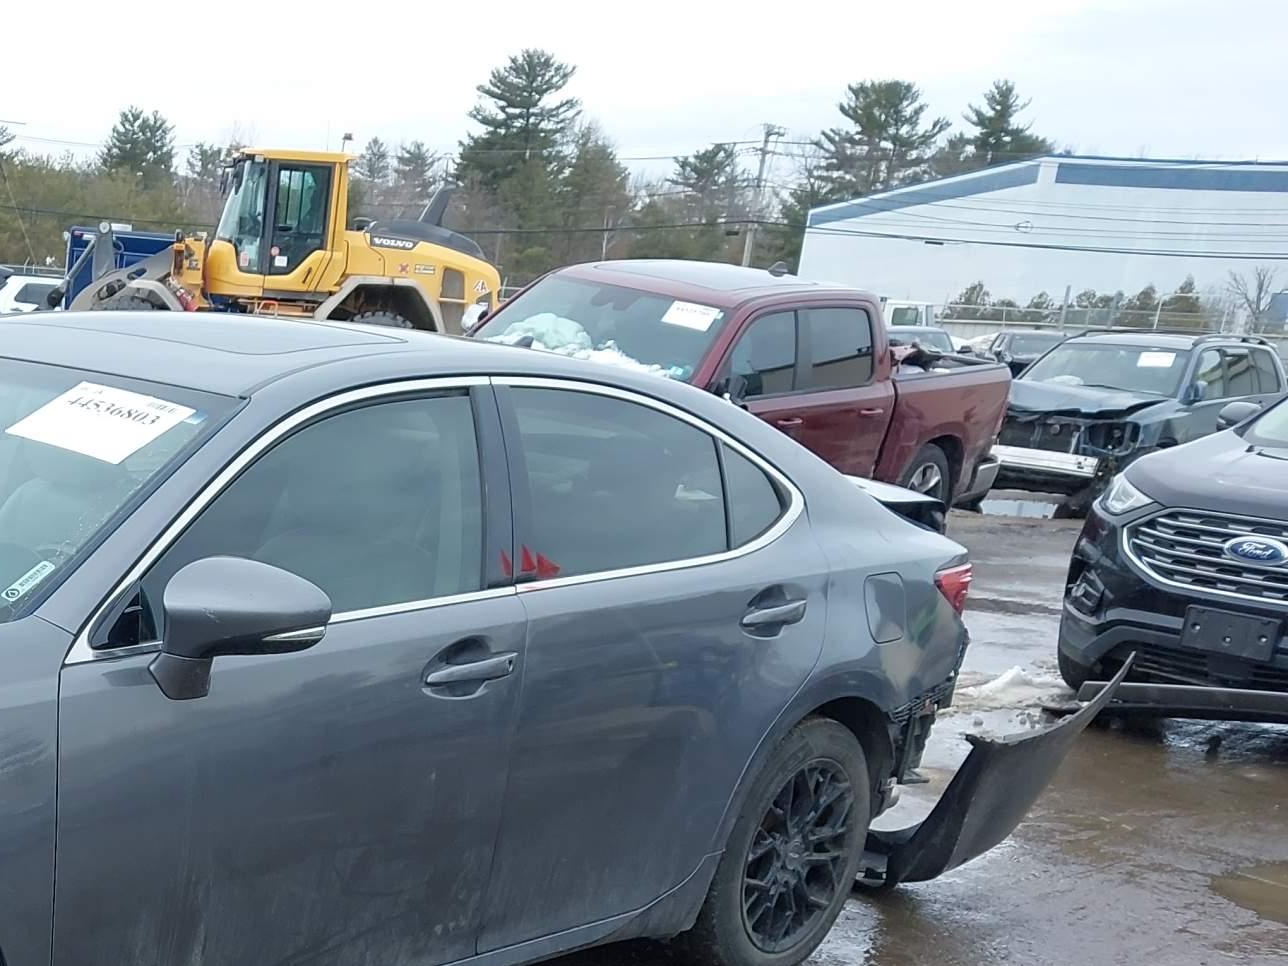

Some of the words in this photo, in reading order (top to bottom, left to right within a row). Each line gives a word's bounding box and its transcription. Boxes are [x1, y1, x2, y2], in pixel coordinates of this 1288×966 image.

[373, 237, 414, 249] VOLVO
[67, 396, 161, 425] 44536803
[1238, 541, 1275, 559] Ford
